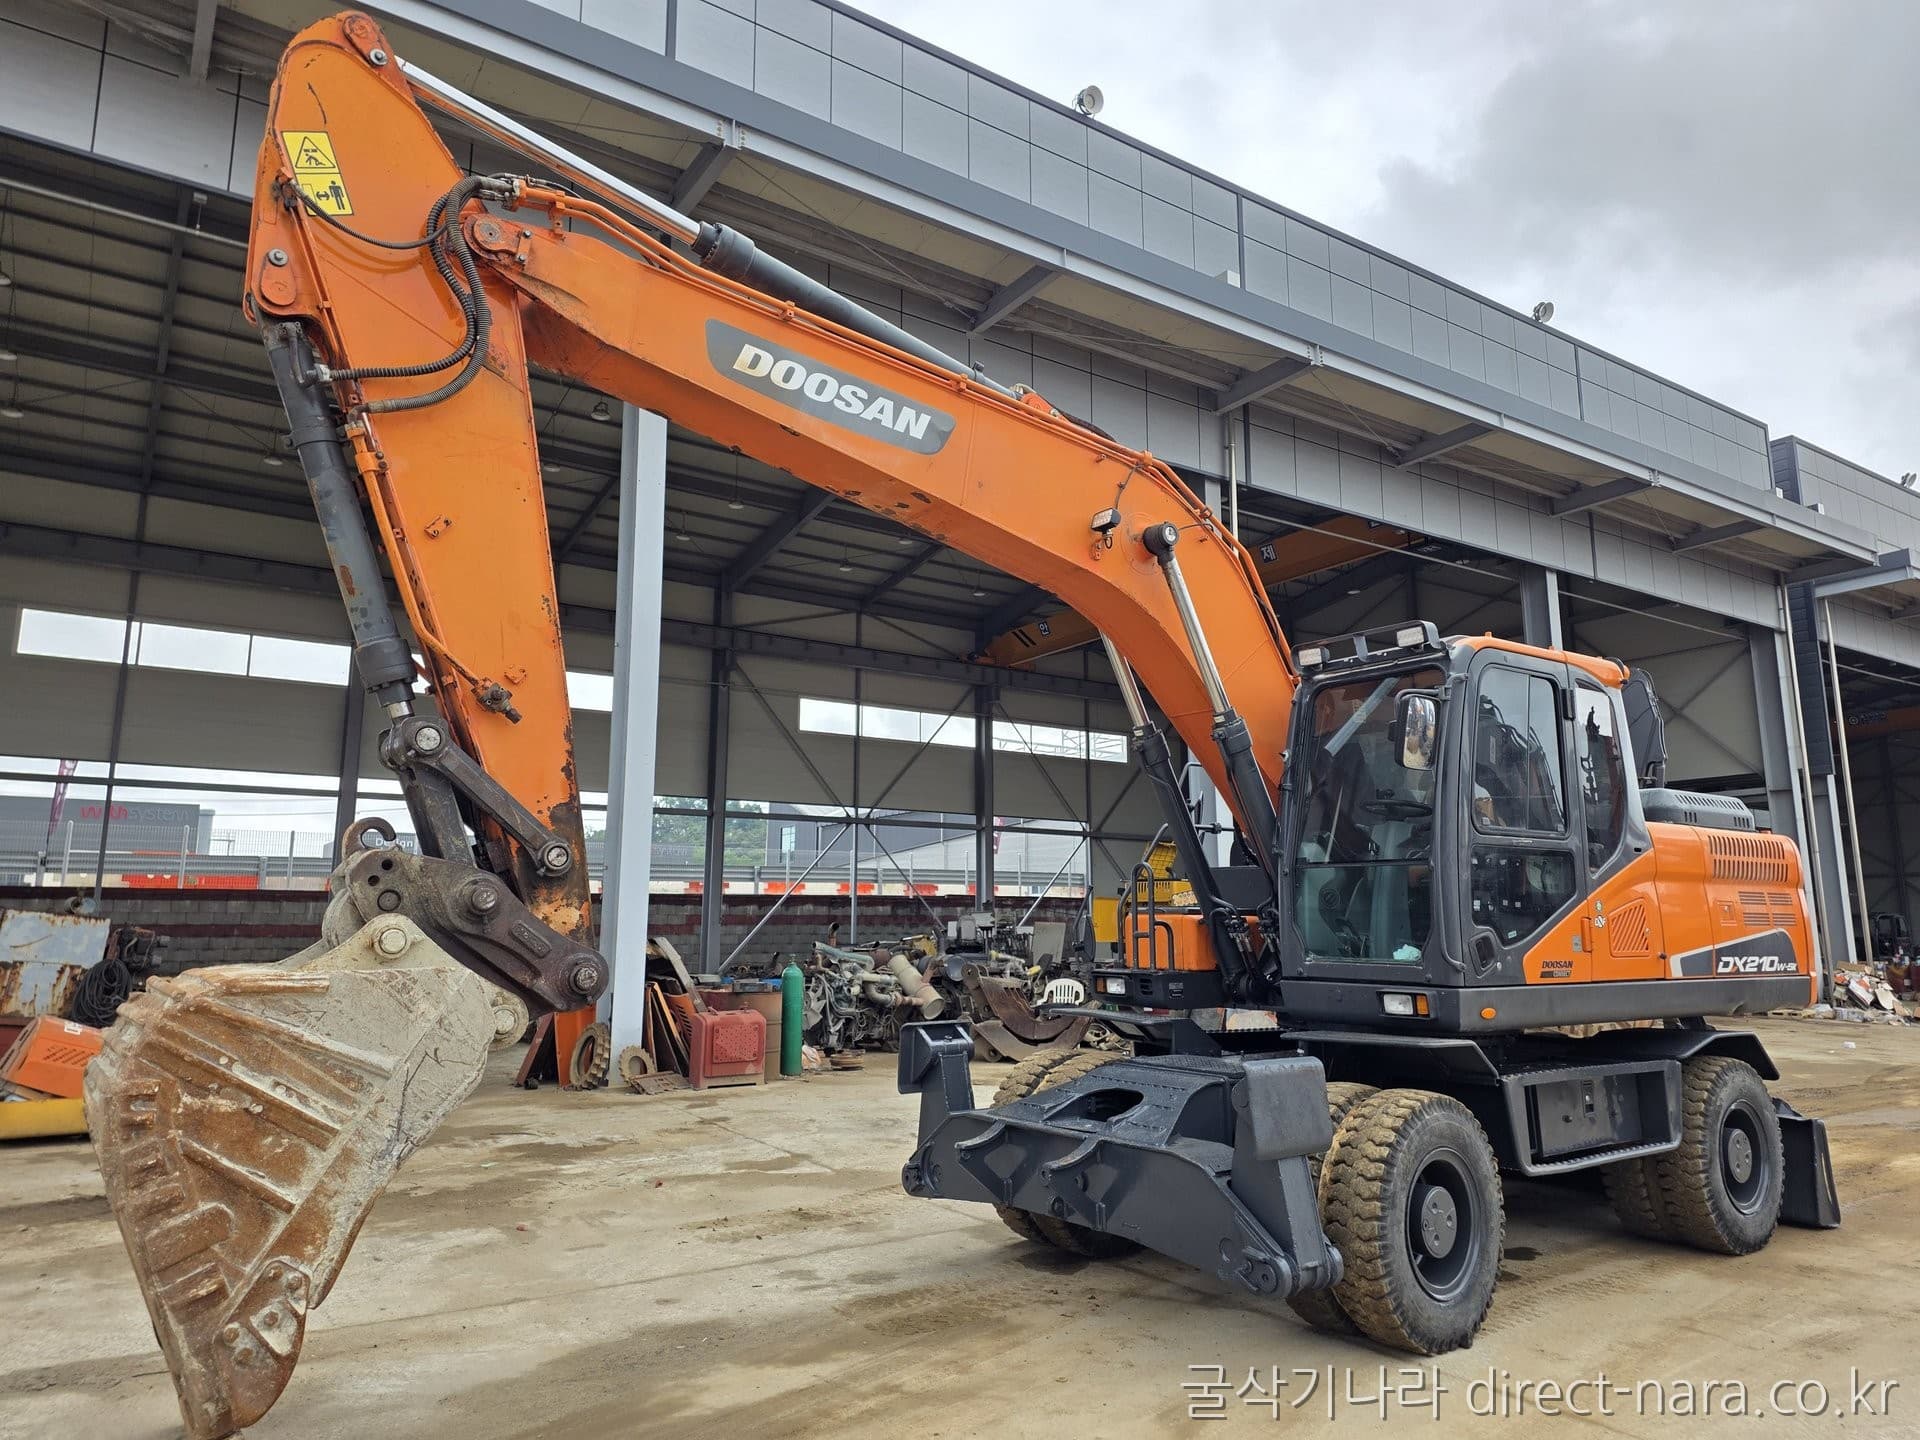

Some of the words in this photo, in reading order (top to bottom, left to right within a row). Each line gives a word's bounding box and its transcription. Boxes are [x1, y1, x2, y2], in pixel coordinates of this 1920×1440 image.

[733, 343, 931, 439] DOOSAN
[1261, 544, 1277, 561] 제
[1541, 960, 1574, 969] DOOSAN
